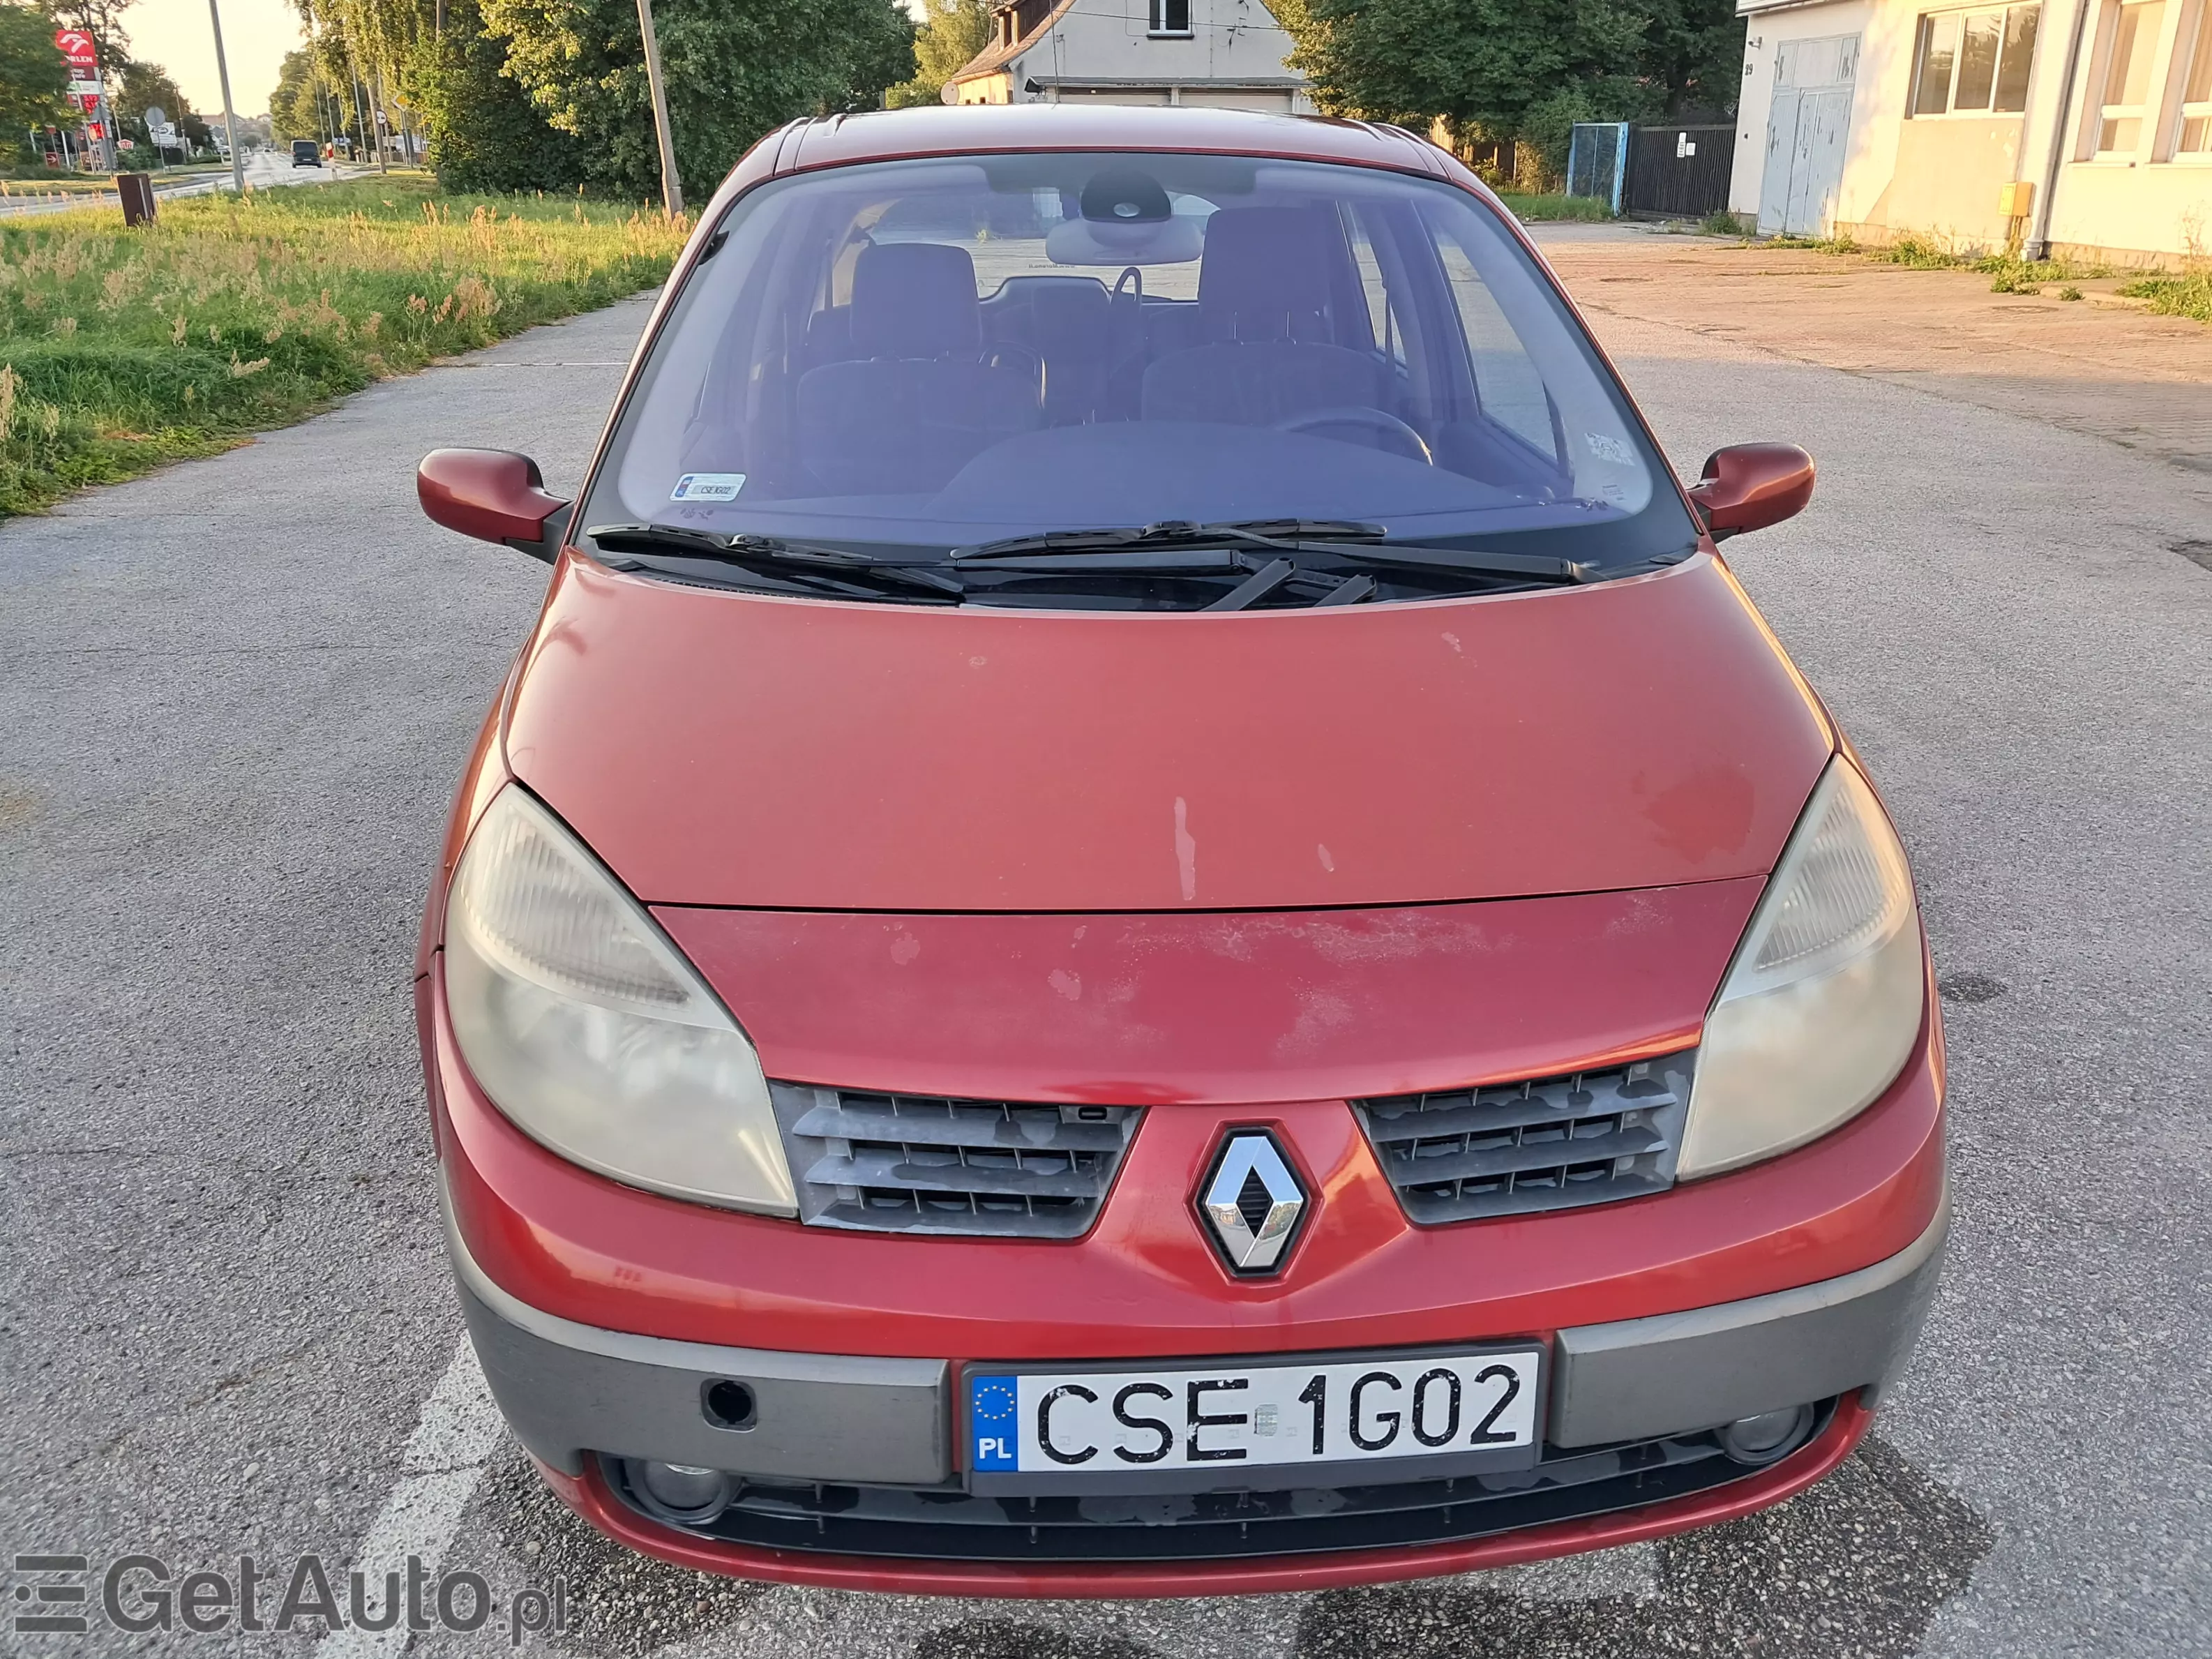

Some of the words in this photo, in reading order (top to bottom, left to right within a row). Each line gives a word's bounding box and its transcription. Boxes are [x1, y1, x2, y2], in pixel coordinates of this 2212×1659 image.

[1745, 63, 1754, 76] 29
[1037, 1379, 1249, 1465] CSE
[1298, 1365, 1521, 1455] 1G02
[979, 1438, 1012, 1459] PL
